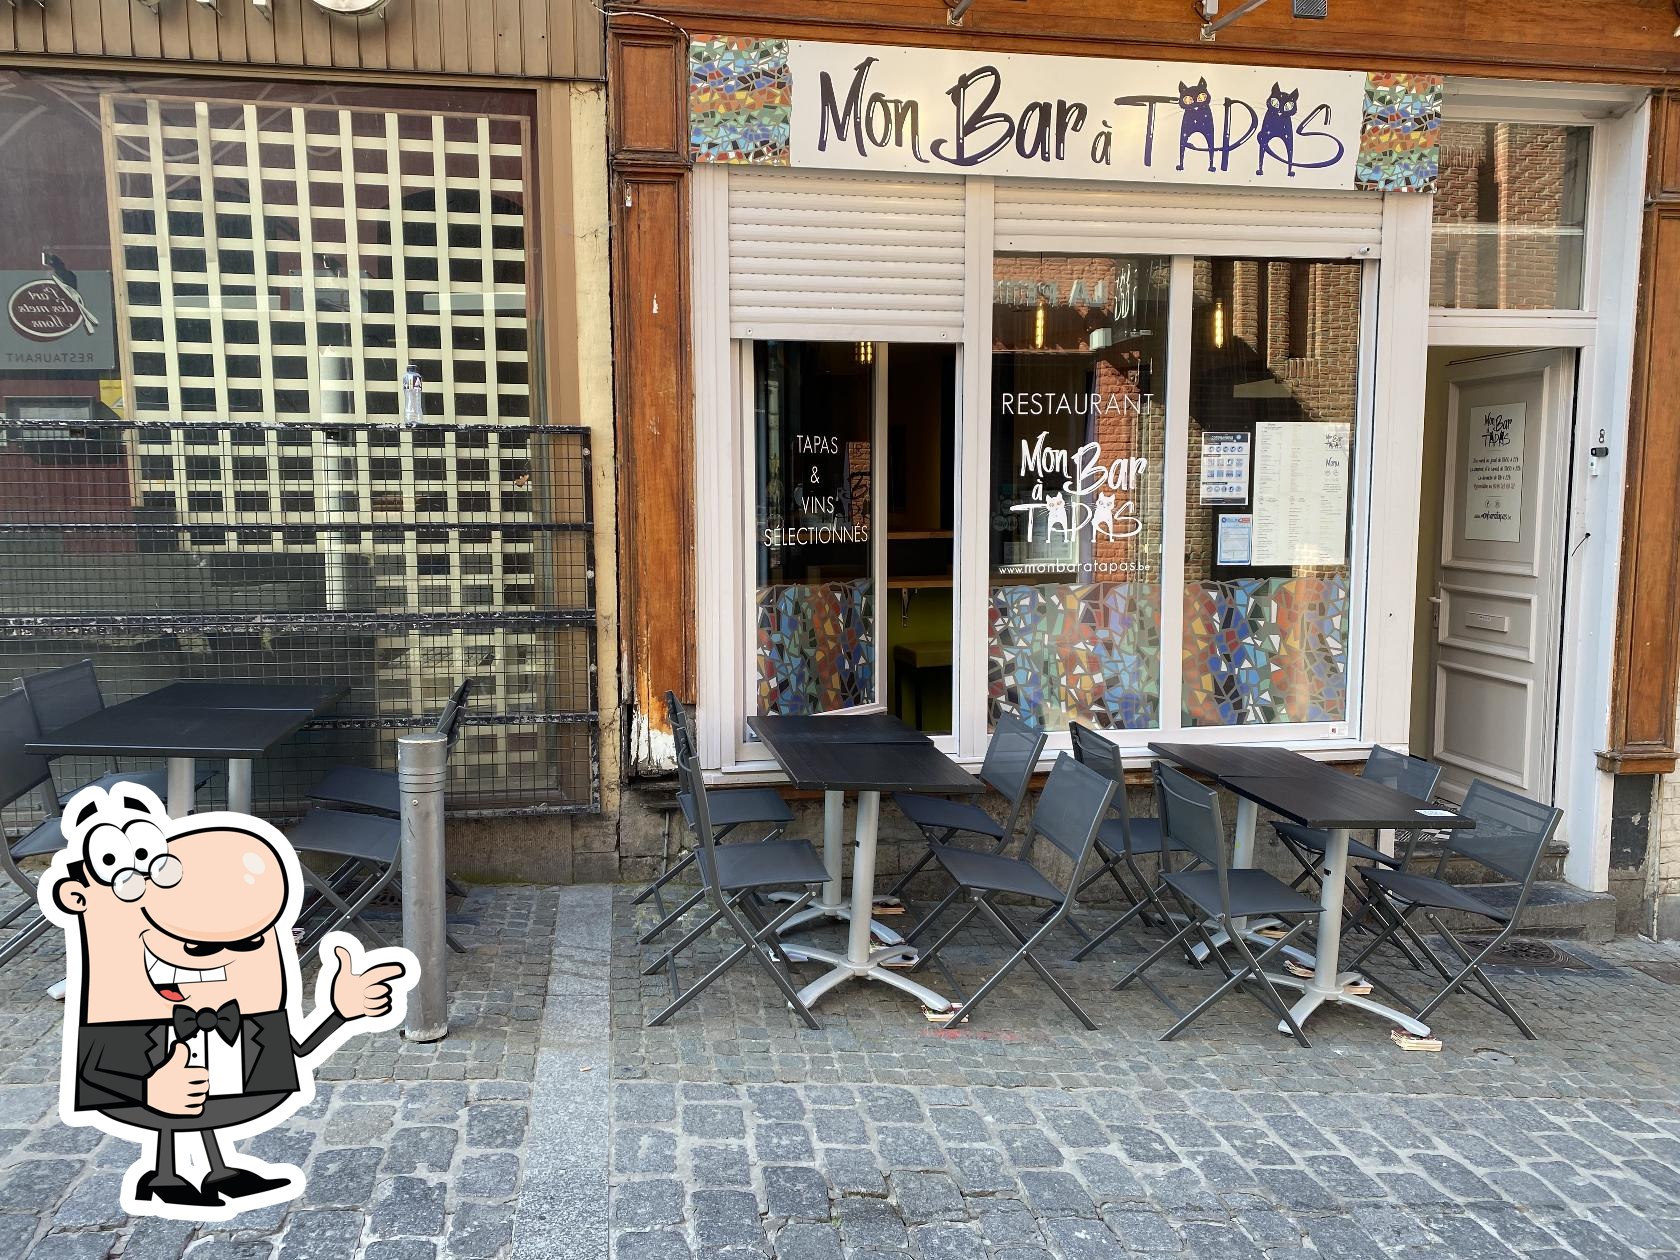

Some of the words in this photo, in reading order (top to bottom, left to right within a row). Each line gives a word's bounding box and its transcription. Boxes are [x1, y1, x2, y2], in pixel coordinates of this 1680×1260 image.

[818, 56, 930, 164] Mon
[930, 65, 1088, 168] Bar
[1090, 119, 1113, 165] à
[1114, 76, 1345, 178] TAPAS
[1002, 393, 1154, 415] RESTAURANT
[796, 434, 839, 455] TAPAS
[1020, 431, 1072, 479] Mon
[1063, 441, 1148, 496] Bar
[810, 465, 820, 484] &
[1031, 479, 1043, 500] à
[801, 496, 835, 514] VINS
[1010, 491, 1143, 543] TAPAS
[763, 522, 868, 547] SÉLECTIONNÉS
[998, 558, 1150, 575] www.monbaratapas.be
